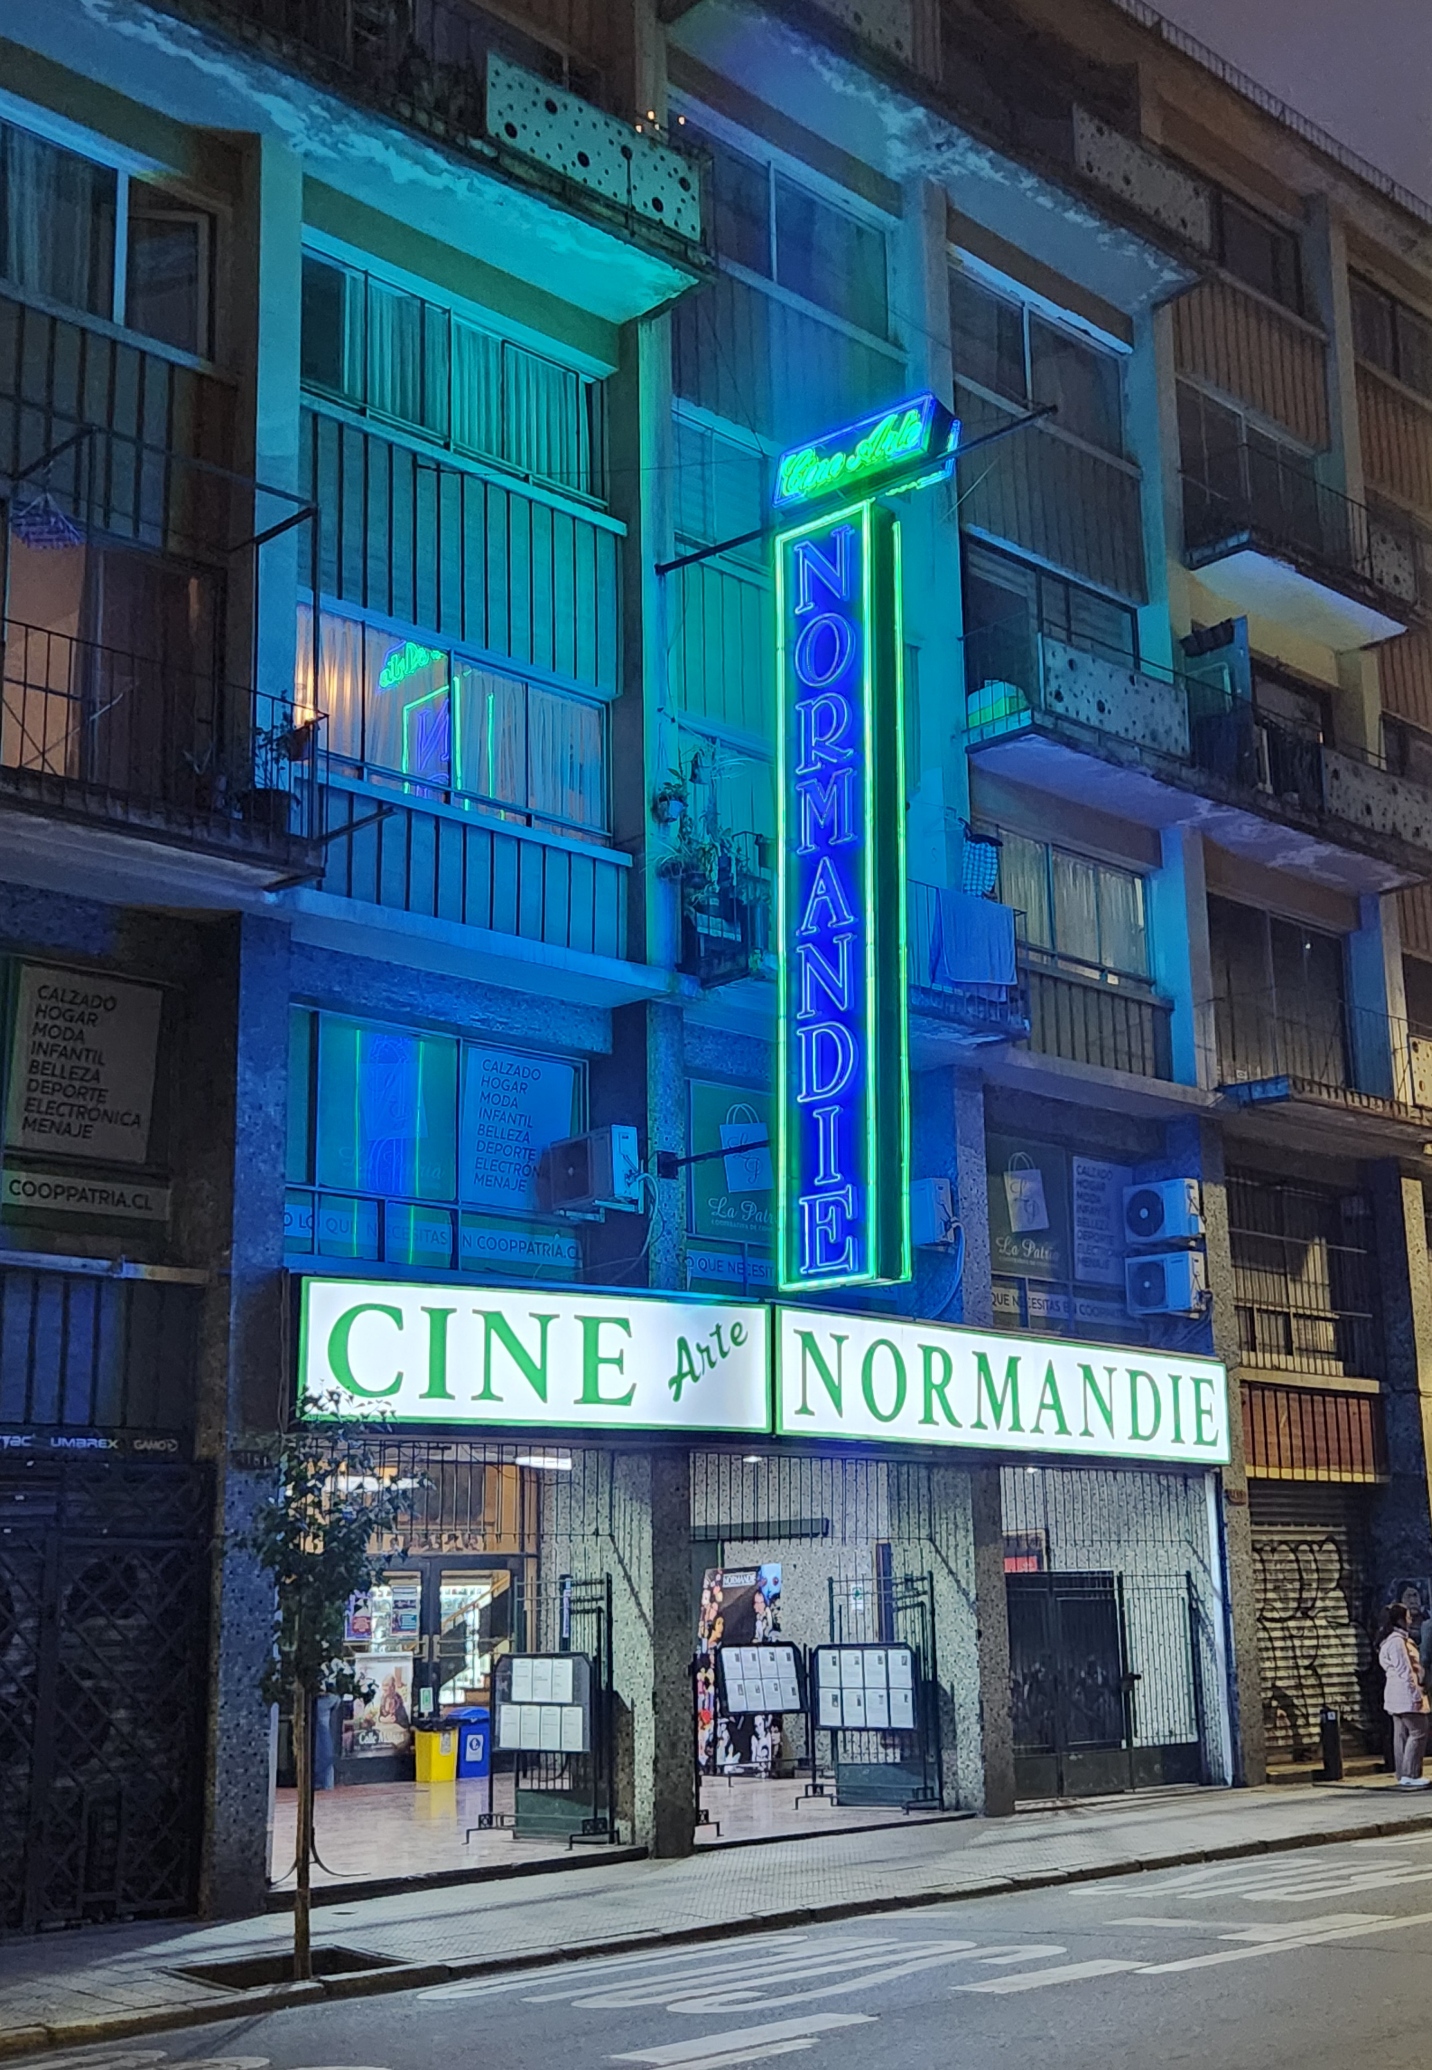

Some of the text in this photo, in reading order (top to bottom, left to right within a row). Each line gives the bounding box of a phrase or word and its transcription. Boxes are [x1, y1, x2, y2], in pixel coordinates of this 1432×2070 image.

[794, 523, 859, 1277] NORMANDIE
[37, 984, 118, 1012] CALZADO
[34, 1003, 99, 1028] HOGAR
[31, 1022, 86, 1046] MODA
[30, 1040, 106, 1067] INFANTIL
[27, 1059, 101, 1085] BELLEZA
[482, 1058, 542, 1081] CALZADO
[26, 1078, 109, 1105] DEPORTE
[480, 1075, 529, 1095] HOGAR
[479, 1091, 519, 1110] MODA
[21, 1116, 95, 1140] MENAJE
[478, 1106, 534, 1129] INFANTIL
[477, 1123, 531, 1145] BELLEZA
[476, 1139, 537, 1162] DEPORTE
[473, 1172, 528, 1193] MENAJE
[8, 1178, 152, 1212] COOPPATRIA.CL
[708, 1197, 739, 1220] La
[995, 1236, 1019, 1257] La
[697, 1257, 724, 1273] QUE
[326, 1302, 749, 1407] CINE Arte
[792, 1328, 1220, 1448] NORMANDIE
